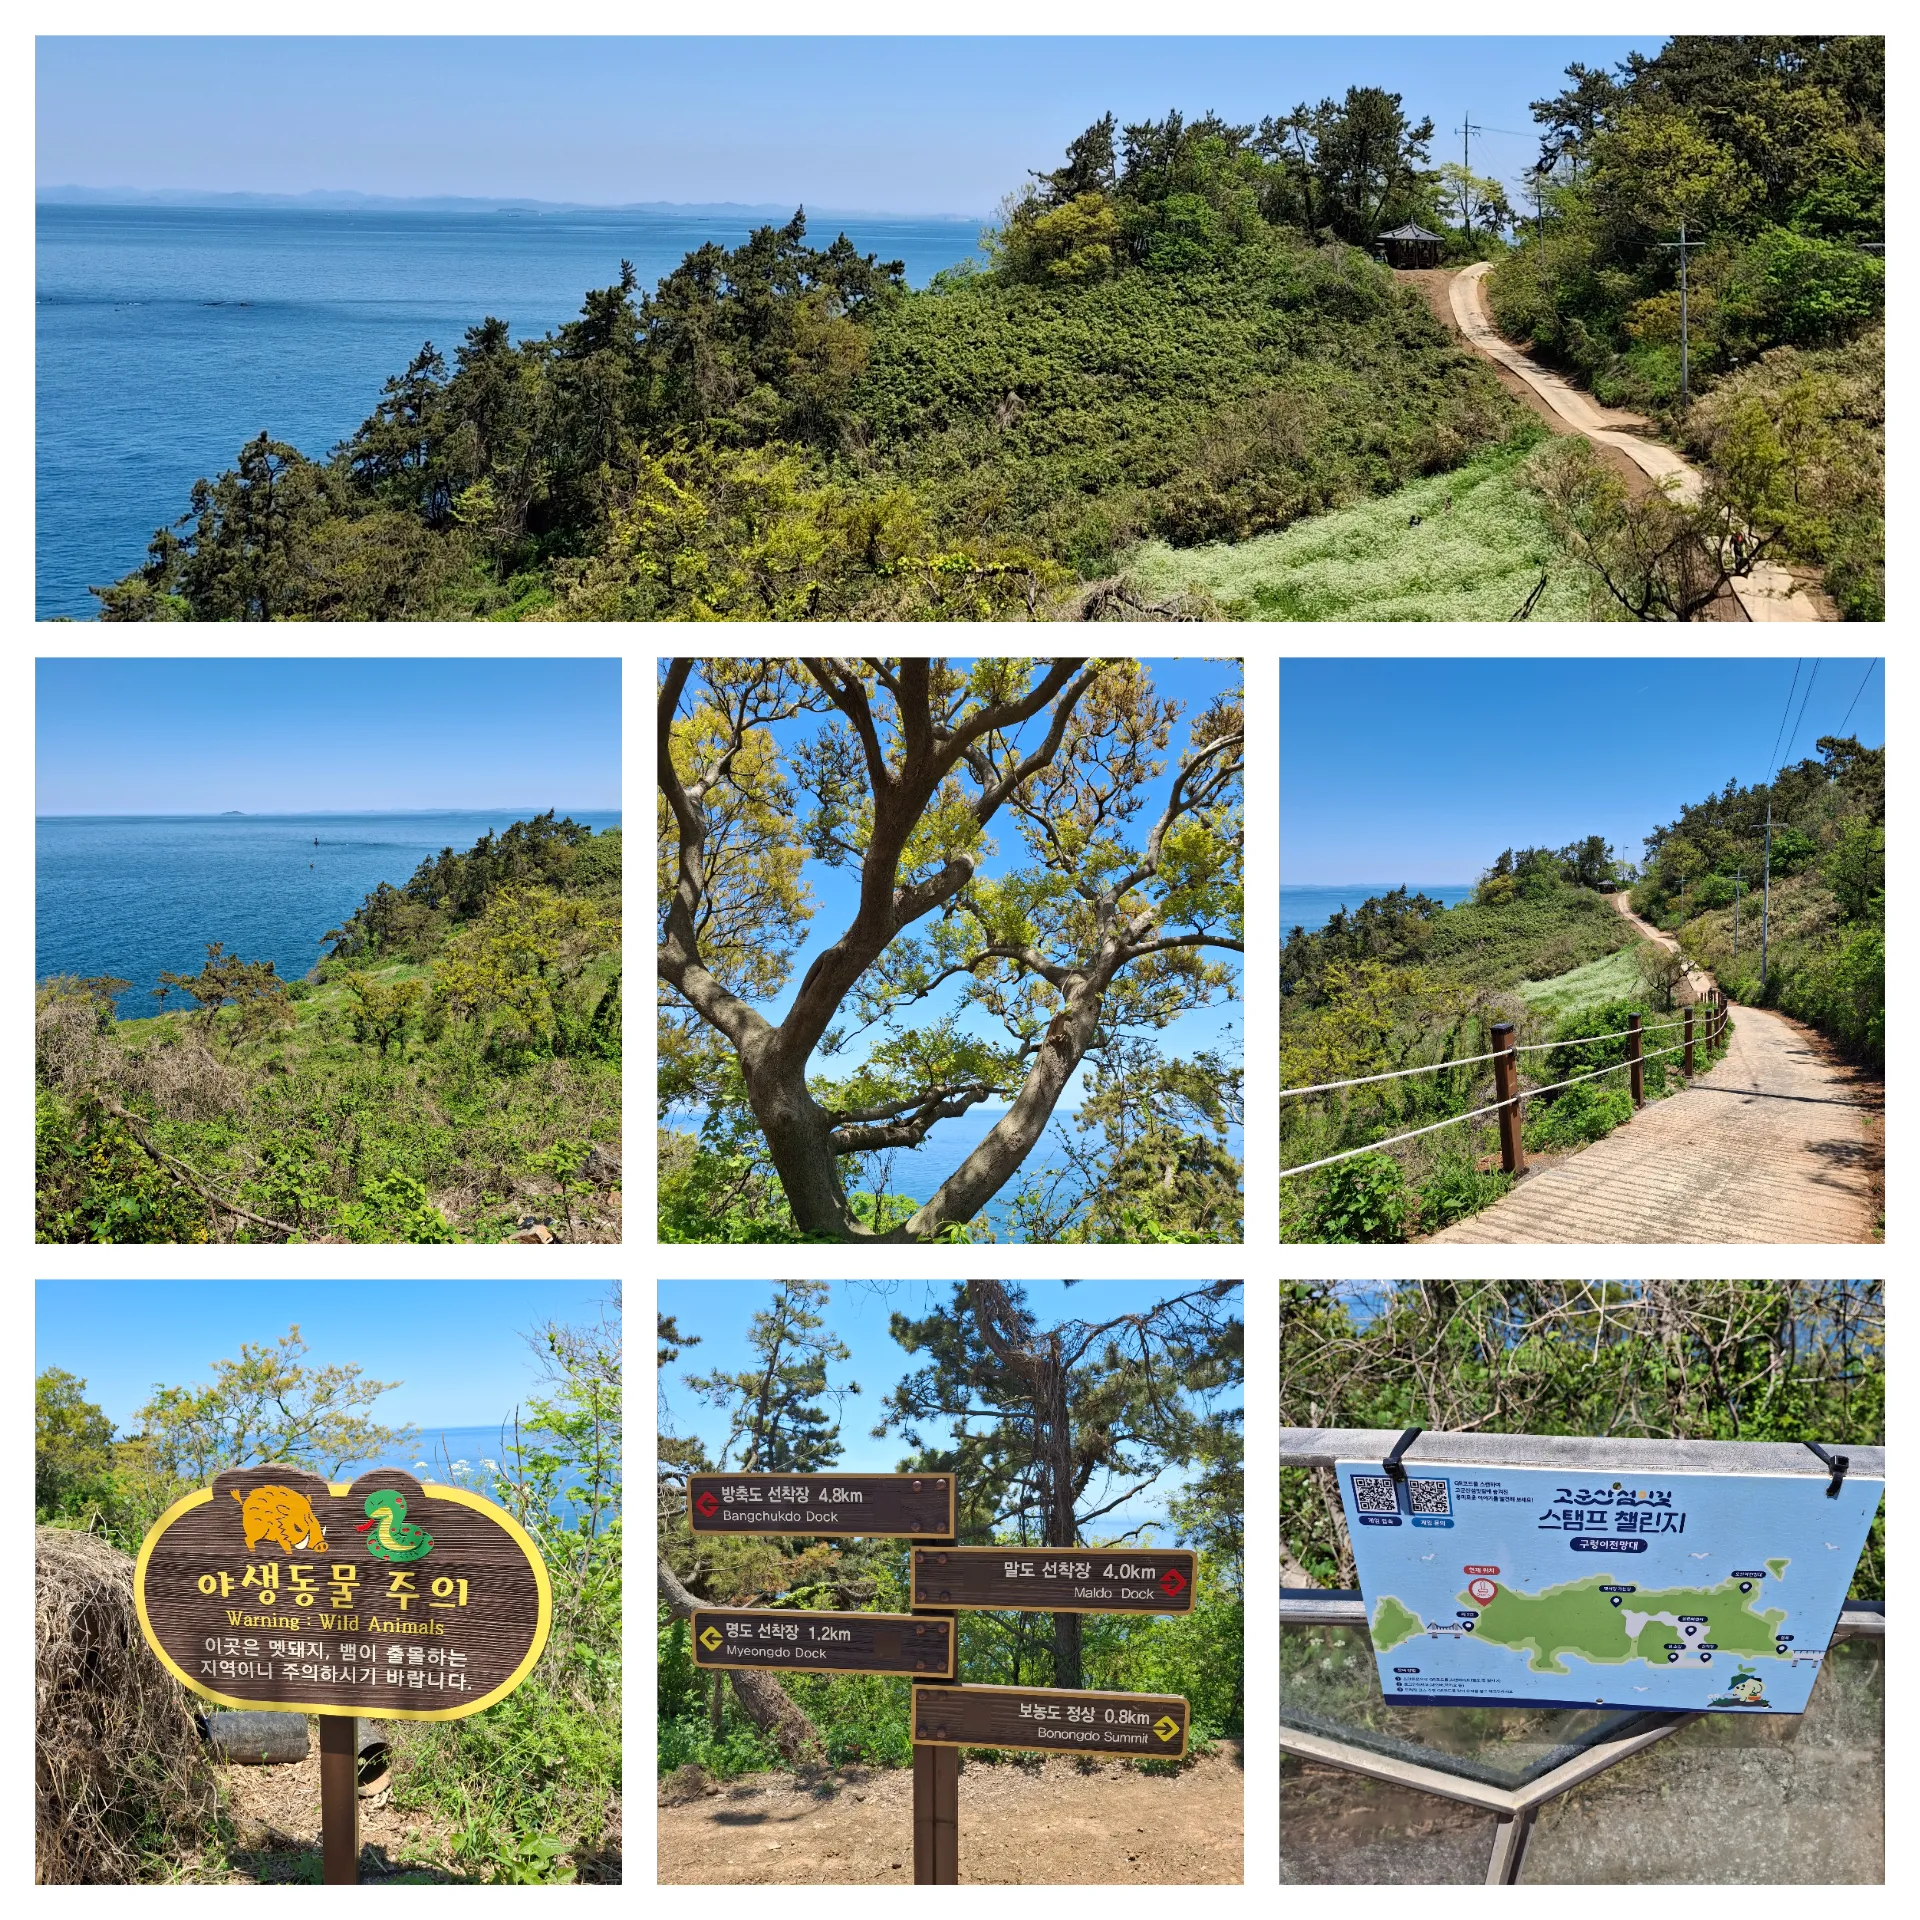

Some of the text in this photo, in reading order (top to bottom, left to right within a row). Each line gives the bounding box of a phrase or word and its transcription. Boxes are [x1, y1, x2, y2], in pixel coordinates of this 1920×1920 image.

[721, 1486, 863, 1504] 방축도 선착장 4.8km
[723, 1510, 839, 1523] Bangchukdo Dock
[1538, 1509, 1686, 1533] 스탬프 챌린지
[1579, 1539, 1639, 1551] 구렁이전망대
[1004, 1561, 1156, 1580] 말도 선착장 4.0km
[198, 1562, 468, 1610] 야생동물 주의
[1074, 1587, 1155, 1600] Maldo Dock
[226, 1610, 300, 1631] Warning
[319, 1613, 360, 1632] Wild
[368, 1616, 445, 1636] Animals
[726, 1623, 851, 1642] 명도 선착장 1.2km
[205, 1637, 468, 1668] 이곳은 멧돼지, 뱀이 출몰하는
[727, 1645, 827, 1659] Myeongdo Dock
[200, 1659, 472, 1691] 지역이니 주의하시기 바랍니다.
[1018, 1703, 1150, 1725] 보농도 정상 0.8km
[1038, 1727, 1149, 1744] Bonongdo Summit
